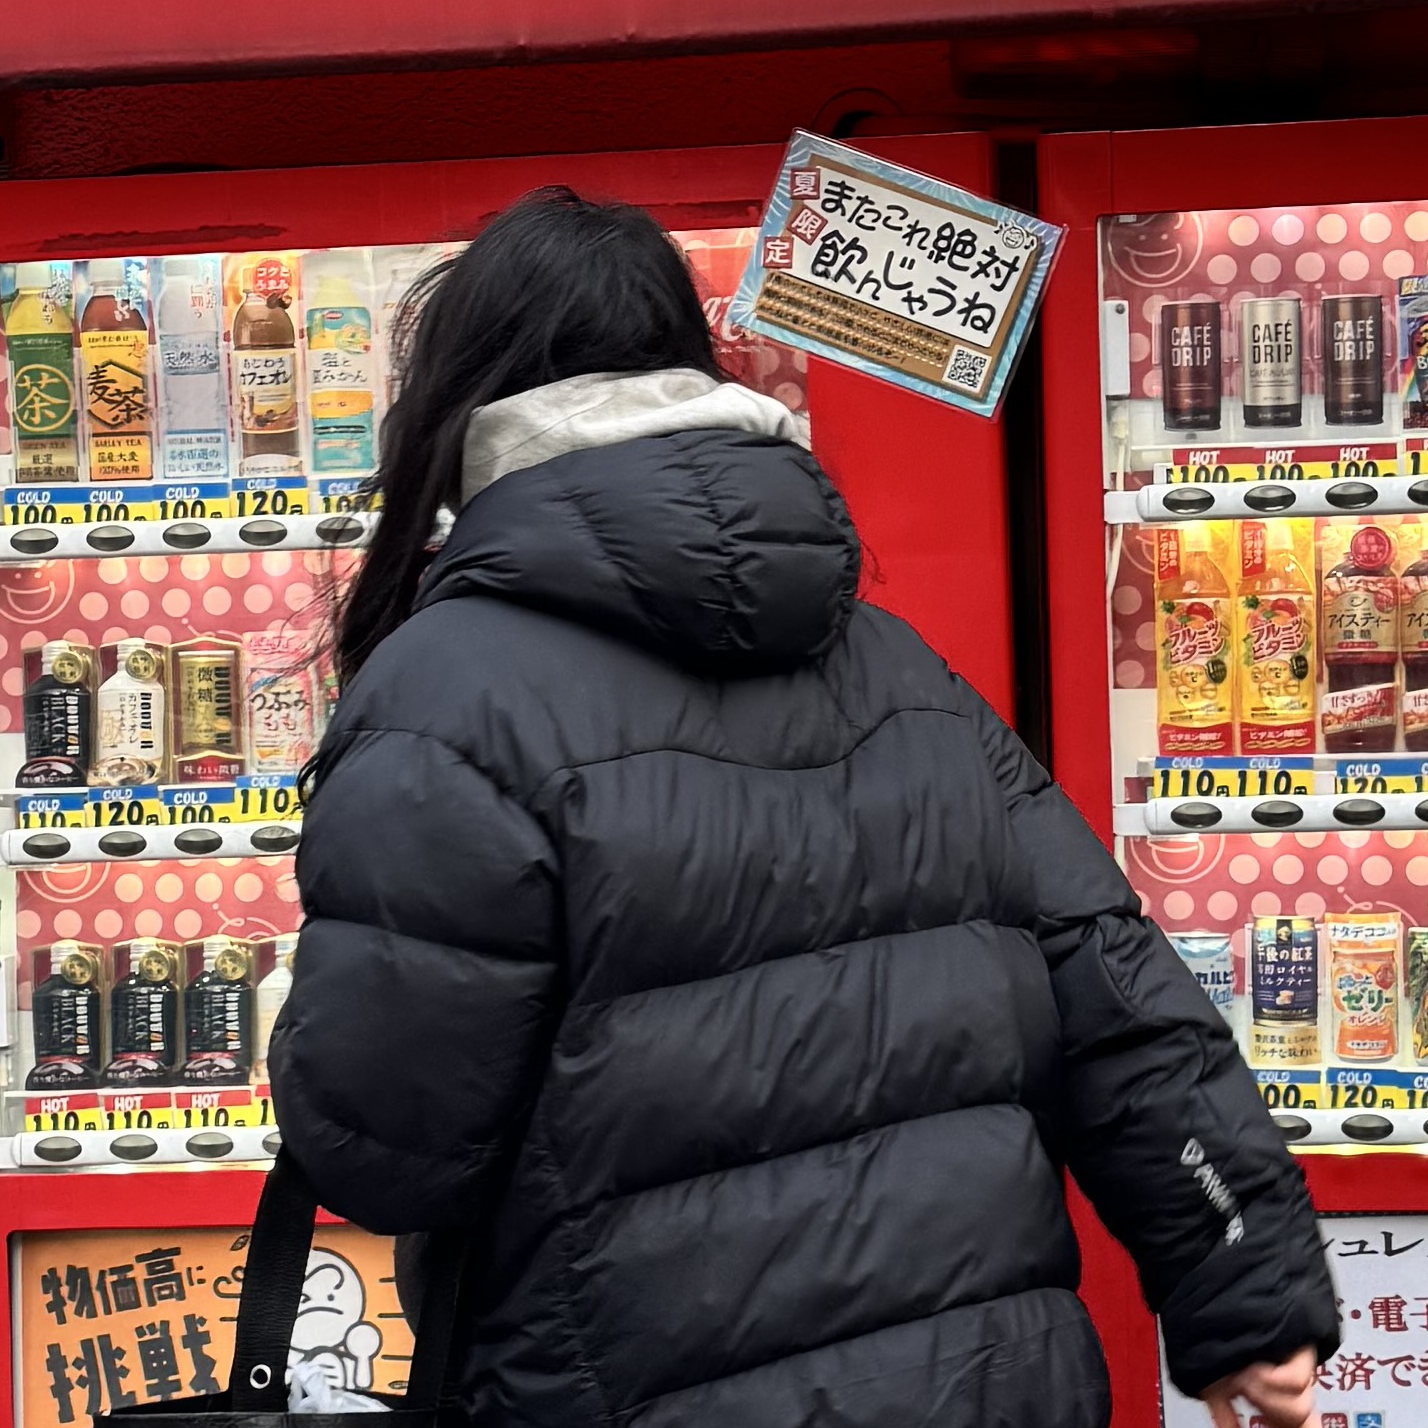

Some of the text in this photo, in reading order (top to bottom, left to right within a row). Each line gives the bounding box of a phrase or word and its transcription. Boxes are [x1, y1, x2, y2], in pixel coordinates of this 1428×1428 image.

[821, 181, 1019, 292] またこれ絶対
[812, 230, 996, 334] 飲んじゃうね
[1171, 322, 1212, 349] CAFÉ
[1252, 319, 1293, 345] CAFÉ
[1333, 316, 1374, 343] CAFÉ
[1172, 346, 1212, 368] DRIP
[1252, 342, 1293, 365] DRIP
[1334, 341, 1374, 362] DRIP
[17, 372, 68, 425] 茶
[88, 366, 147, 423] 麦茶
[1189, 450, 1220, 465] HOT
[1265, 450, 1295, 464] HOT
[1339, 446, 1370, 461] HOT
[247, 479, 278, 490] COLD
[17, 491, 51, 503] COLD
[90, 490, 123, 502] COLD
[166, 487, 200, 499] COLD
[1328, 612, 1391, 628] アイスティー
[1172, 757, 1203, 769] COLD
[1250, 757, 1281, 769] COLD
[1346, 763, 1381, 777] COLD
[251, 775, 280, 788] COLD
[102, 789, 133, 802] COLD
[173, 791, 208, 805] COLD
[28, 799, 61, 812] COLD
[1337, 1072, 1372, 1085] COLD
[40, 1097, 69, 1113] HOT
[114, 1096, 144, 1111] HOT
[191, 1093, 221, 1108] HOT
[42, 1247, 206, 1325] 物価高に
[46, 1314, 221, 1423] 挑戦
